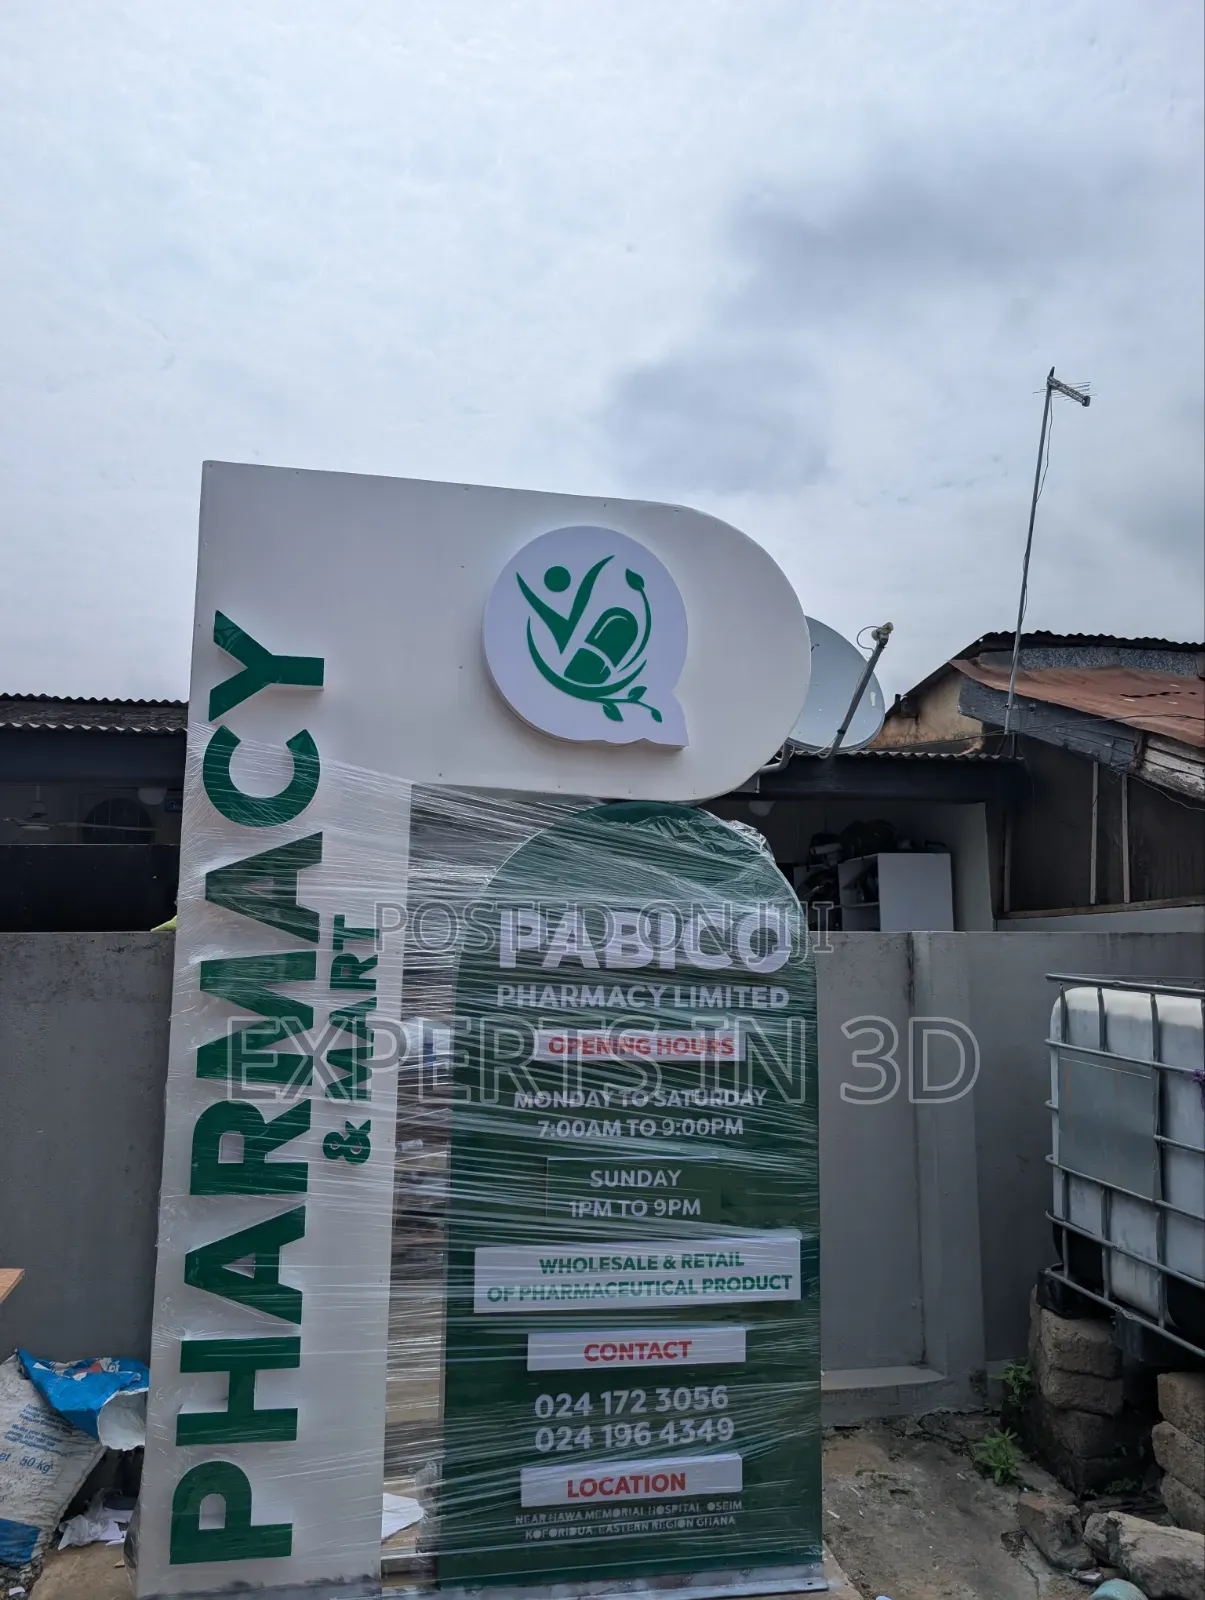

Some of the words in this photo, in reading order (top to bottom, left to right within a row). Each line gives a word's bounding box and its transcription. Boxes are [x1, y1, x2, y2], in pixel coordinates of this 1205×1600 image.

[499, 907, 792, 973] PABICO
[325, 914, 380, 1101] MART
[497, 985, 664, 1010] PHARMACY
[674, 984, 790, 1009] LIMITED
[548, 1036, 652, 1056] OPENING
[656, 1035, 735, 1055] HOURS
[170, 610, 324, 1565] PHARMACY
[513, 1091, 613, 1109] MONDAY
[621, 1092, 648, 1108] TO
[653, 1089, 768, 1107] SATURDAY
[537, 1119, 621, 1138] 7:00AM
[626, 1119, 656, 1137] TO
[661, 1118, 744, 1137] 9:00PM
[322, 1120, 371, 1165] &
[590, 1169, 682, 1188] SUNDAY
[569, 1200, 612, 1218] 1PM
[618, 1200, 648, 1217] TO
[653, 1198, 701, 1217] 9PM
[539, 1254, 658, 1275] WHOLESALE
[663, 1254, 677, 1270] &
[681, 1250, 745, 1269] RETAIL
[487, 1285, 514, 1303] OF
[519, 1278, 698, 1301] PHARMACEUTICAL
[702, 1274, 793, 1293] PRODUCT
[583, 1340, 692, 1362] CONTACT
[534, 1392, 593, 1418] 024
[600, 1388, 647, 1415] 172
[655, 1384, 729, 1413] 3056
[534, 1425, 592, 1453] 024
[600, 1421, 652, 1448] 196
[658, 1416, 735, 1445] 4349
[566, 1472, 686, 1498] LOCATION
